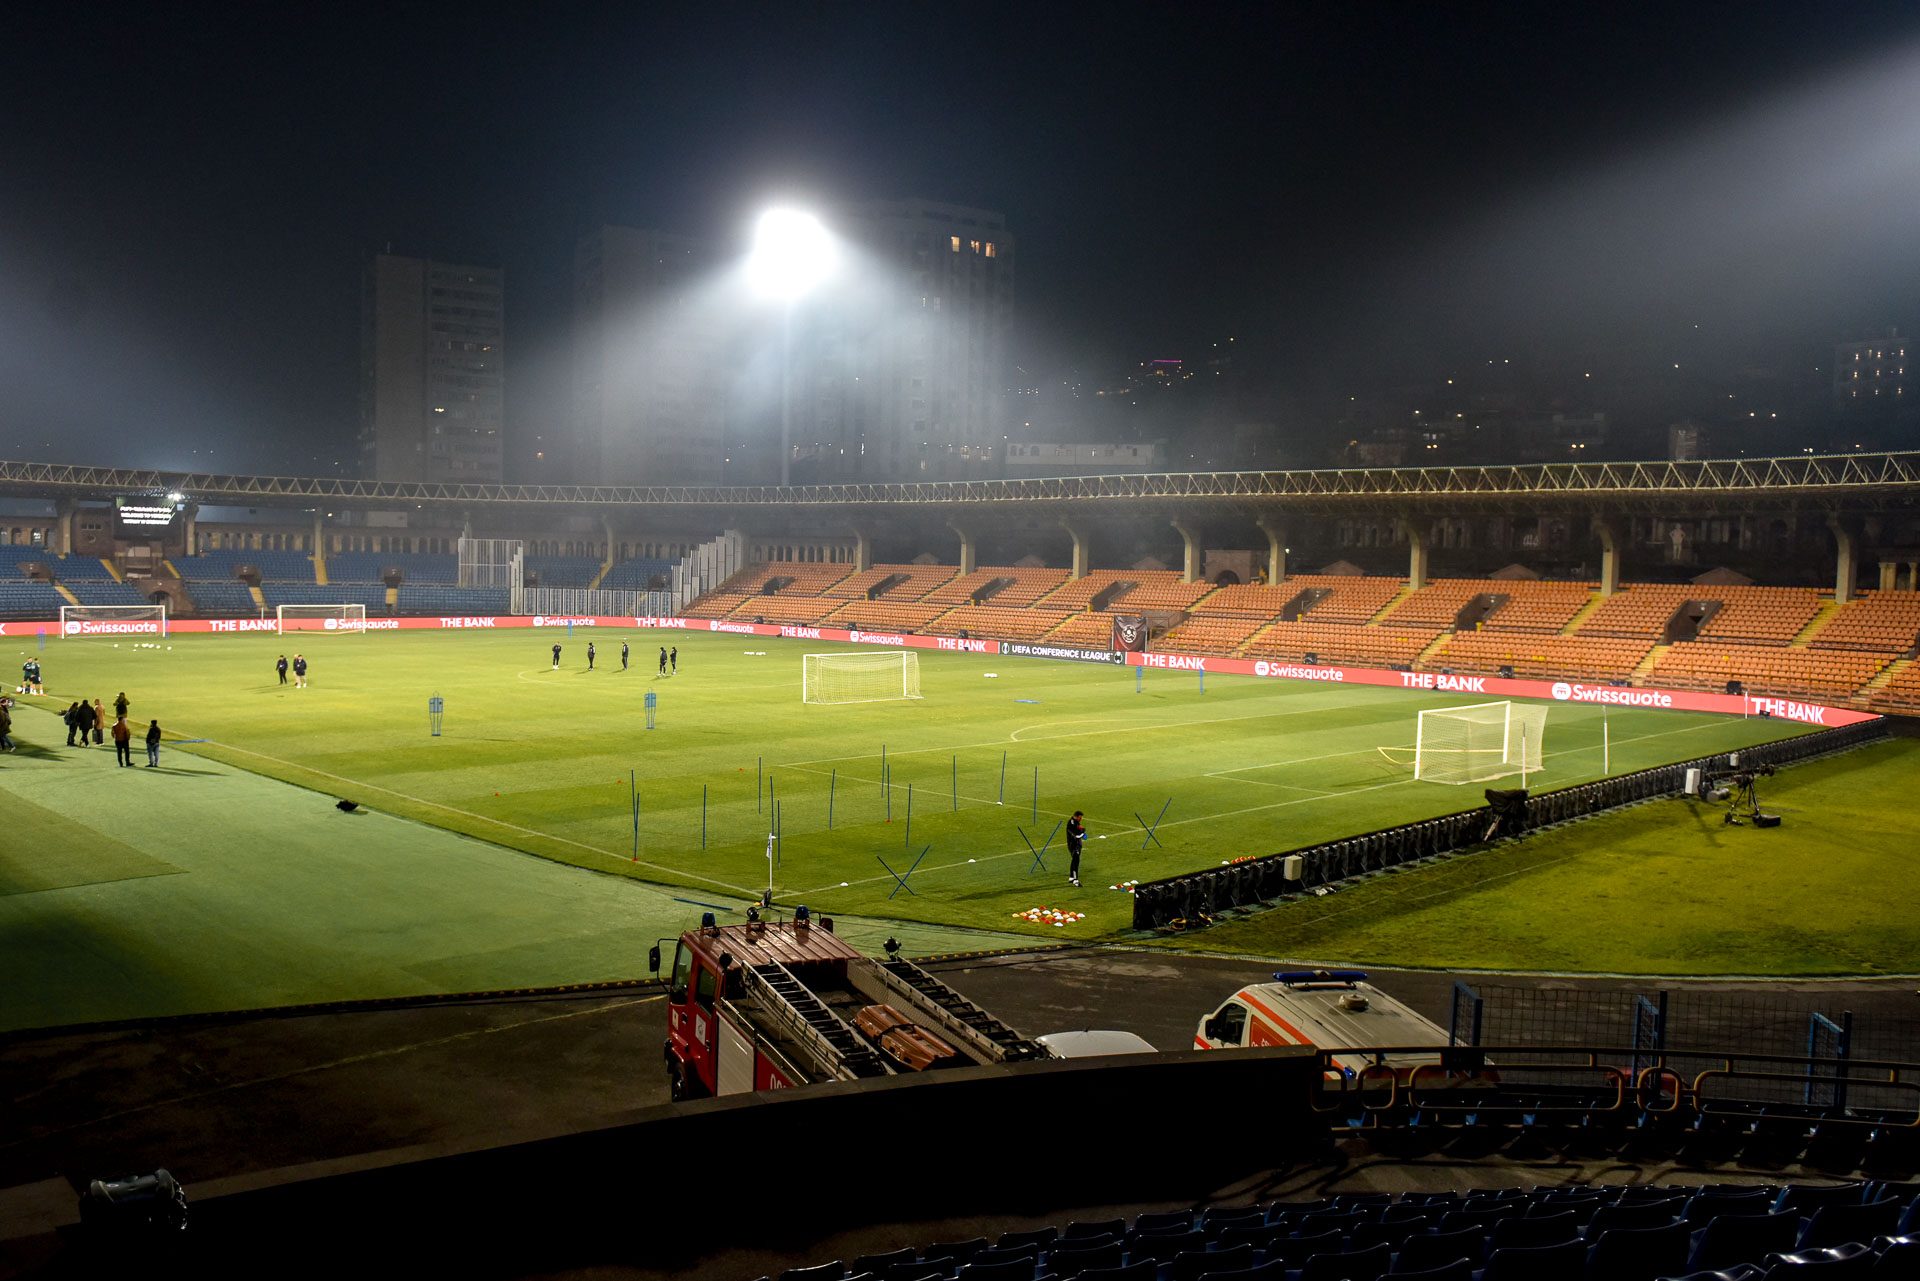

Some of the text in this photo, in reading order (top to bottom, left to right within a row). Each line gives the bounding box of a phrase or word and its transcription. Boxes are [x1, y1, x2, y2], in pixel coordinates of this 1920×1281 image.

[82, 621, 158, 635] Swissquote
[209, 619, 277, 631] THE BANK
[440, 617, 495, 628] THE BANK
[635, 618, 686, 628] THE BANK
[717, 621, 754, 634] Swissquote
[780, 625, 821, 639] THE BANK
[859, 632, 904, 646] Swissquote
[937, 638, 986, 653] THE BANK
[1012, 645, 1031, 655] UEFA
[1032, 647, 1079, 659] CONFERENCE
[1142, 653, 1206, 670] THE BANK
[1270, 663, 1344, 681] Swissquote
[1401, 672, 1486, 692] THE BANK
[1573, 685, 1672, 707] Swissquote
[1751, 697, 1825, 724] THE BANK
